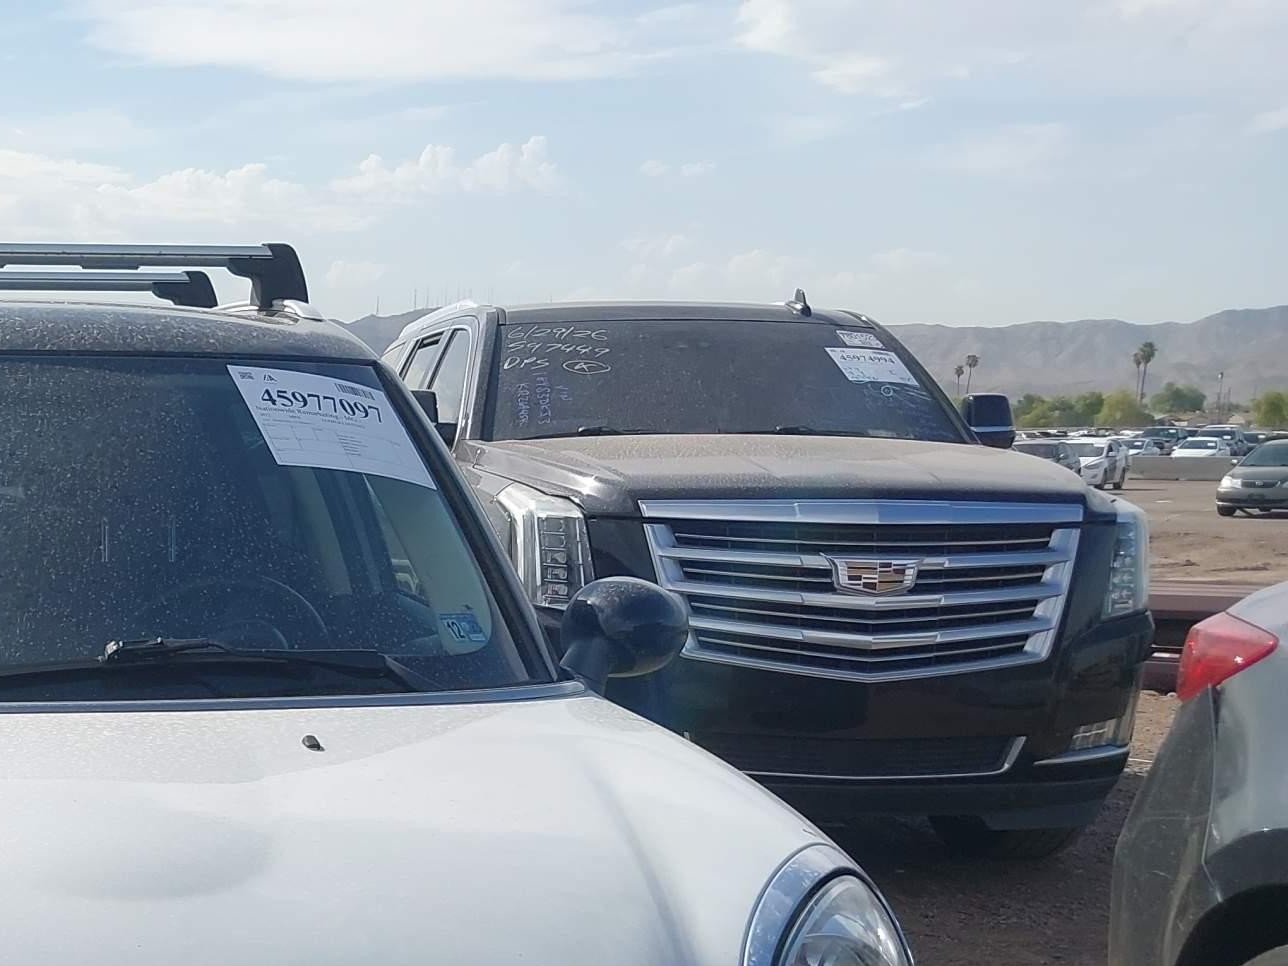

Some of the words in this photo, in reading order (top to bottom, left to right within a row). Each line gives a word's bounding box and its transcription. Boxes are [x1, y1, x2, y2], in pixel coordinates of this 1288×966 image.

[508, 325, 608, 341] 6/29/26
[508, 340, 611, 358] 597449
[503, 356, 550, 370] DPS
[261, 388, 383, 423] 45977097
